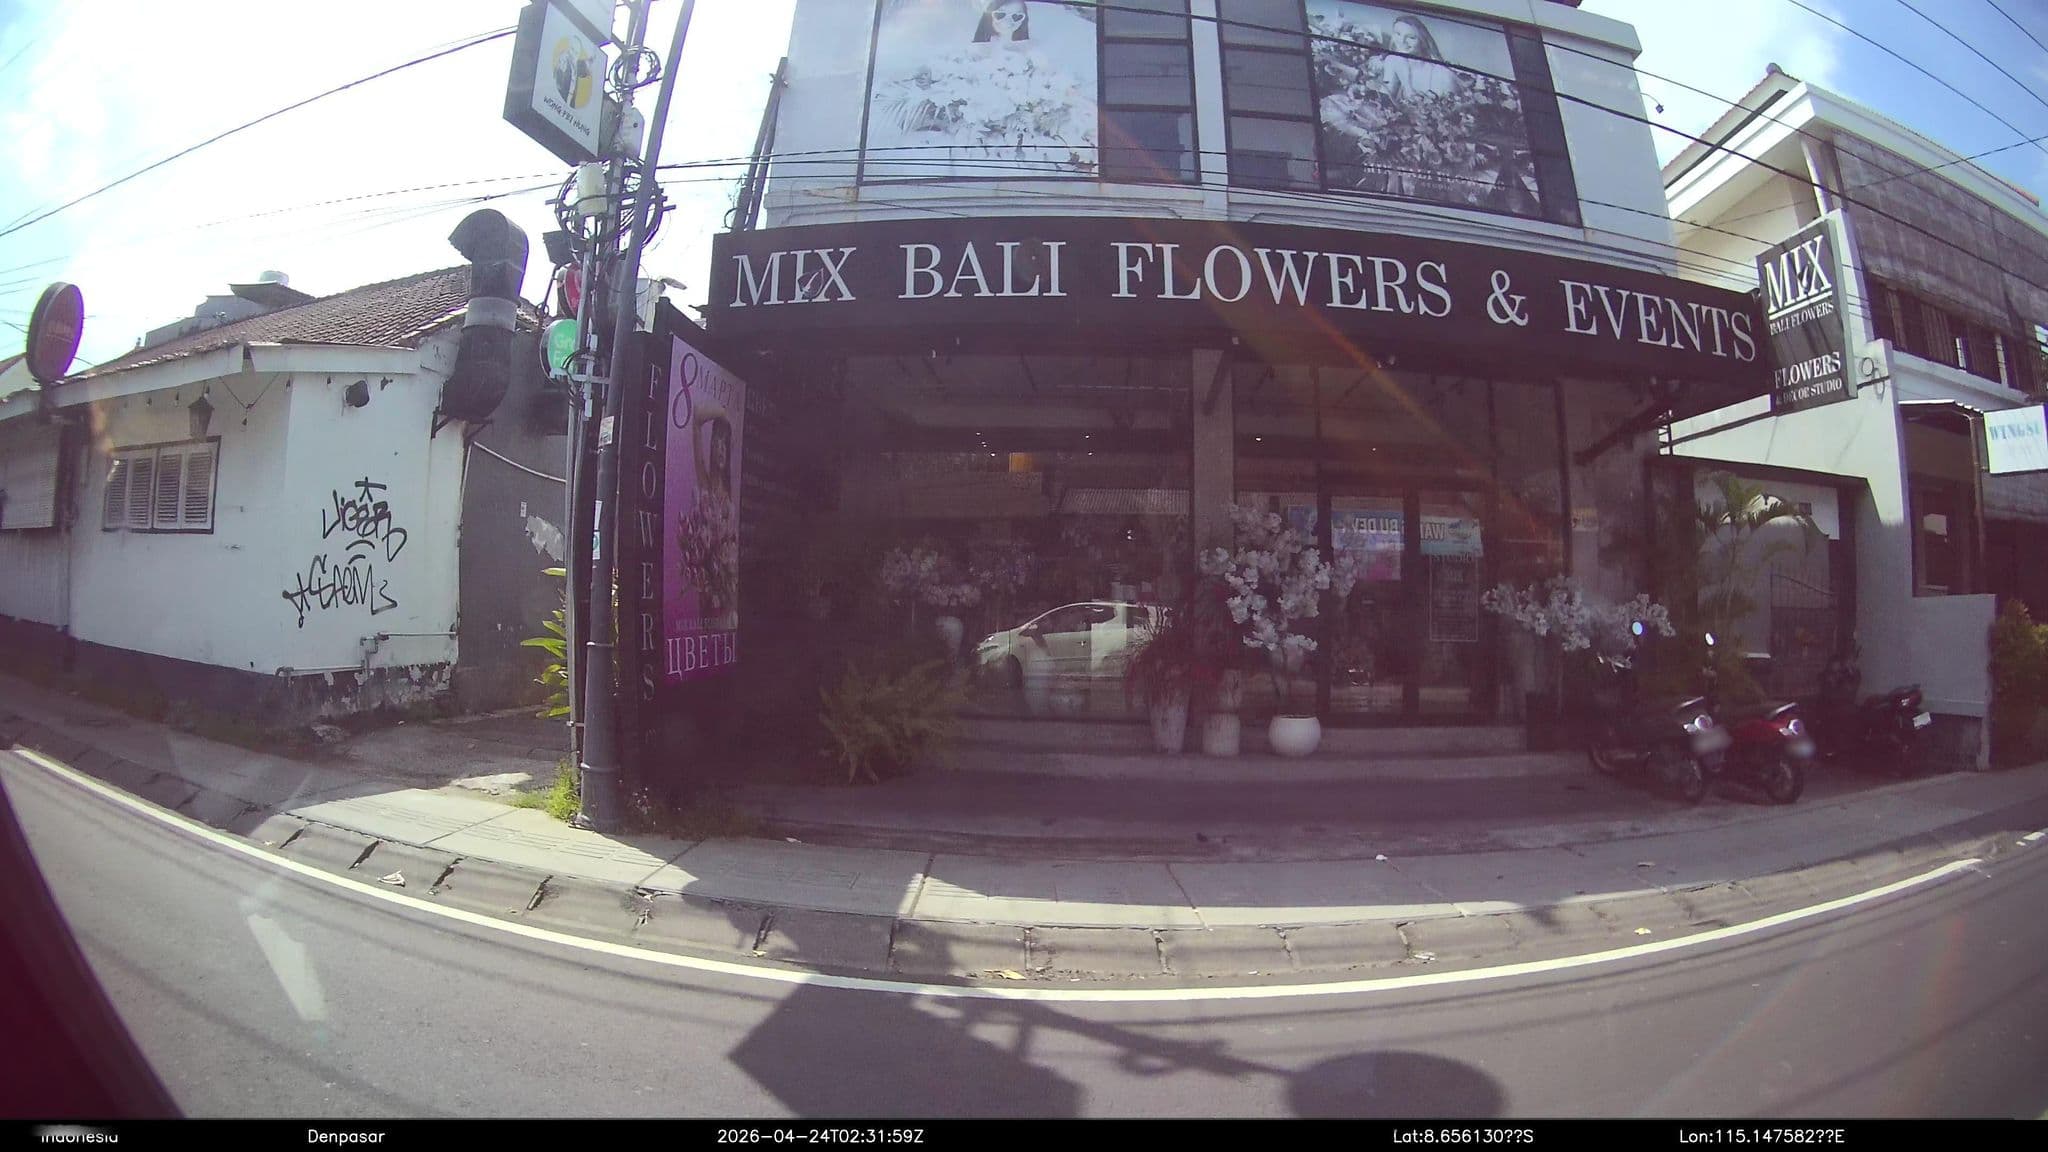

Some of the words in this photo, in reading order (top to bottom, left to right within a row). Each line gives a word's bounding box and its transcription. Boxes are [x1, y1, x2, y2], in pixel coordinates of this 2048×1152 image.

[544, 97, 562, 114] WONG
[573, 119, 590, 136] HUNG
[1764, 235, 1832, 313] MIX
[729, 246, 858, 308] MIX
[898, 241, 1068, 299] BALI
[1110, 242, 1452, 318] FLOWERS
[1486, 270, 1529, 327] &
[1559, 280, 1756, 363] EVENTS
[1769, 317, 1791, 336] BALI
[1791, 301, 1834, 328] FLOWERS
[671, 353, 699, 429] 8
[1774, 351, 1842, 389] FLOWERS
[1810, 377, 1843, 396] STUDIO
[638, 362, 662, 701] FLOWERS
[666, 632, 737, 681] ЦВЕТЫ
